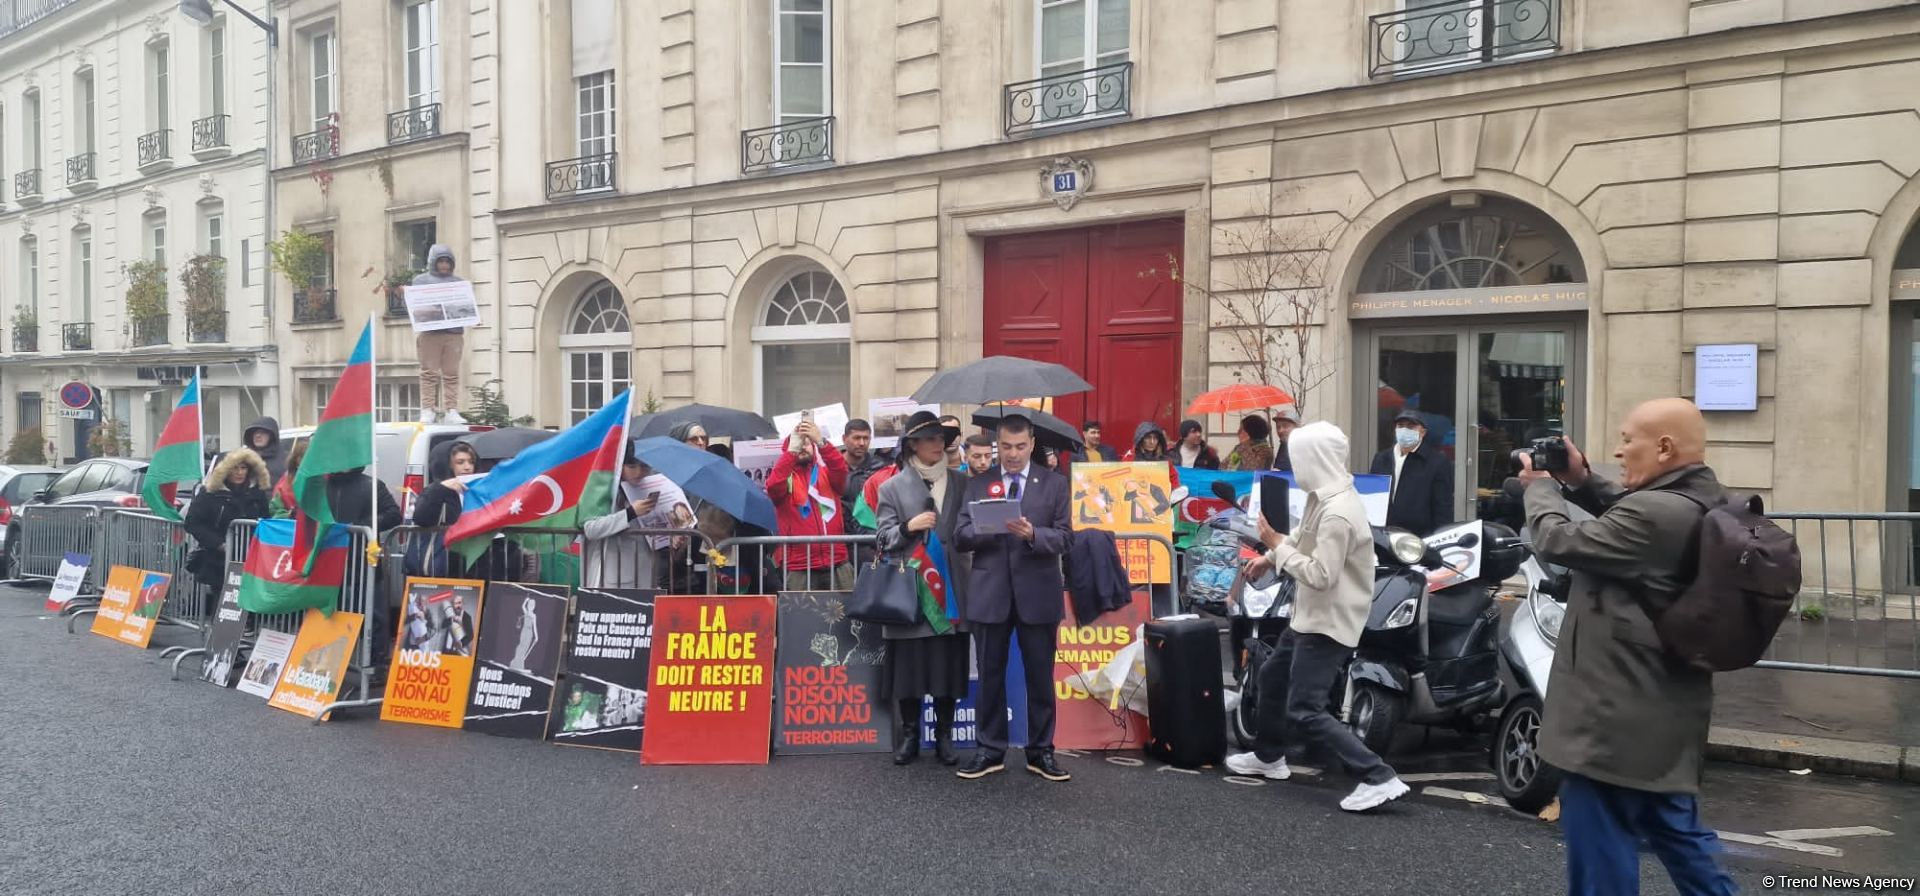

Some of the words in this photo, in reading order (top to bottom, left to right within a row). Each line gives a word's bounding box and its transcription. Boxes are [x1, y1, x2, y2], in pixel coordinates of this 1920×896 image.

[1058, 174, 1072, 190] 31
[1352, 300, 1408, 311] PHILIPPE
[1413, 298, 1473, 308] MENAGER
[1490, 293, 1551, 305] NICOLAS
[580, 610, 600, 622] Pour
[600, 612, 637, 624] apporter
[637, 612, 647, 624] la
[699, 605, 728, 633] LA
[578, 622, 597, 634] Paix
[597, 624, 608, 634] au
[608, 623, 646, 636] Caucase
[1060, 626, 1132, 646] NOUS
[576, 634, 593, 646] Sud
[593, 634, 603, 646] la
[603, 635, 633, 648] France
[633, 636, 652, 649] doit
[666, 632, 758, 661] FRANCE
[399, 648, 442, 667] NOUS
[575, 646, 601, 658] rester
[601, 648, 631, 660] neutre
[395, 665, 451, 686] DISONS
[479, 666, 503, 682] Nous
[656, 664, 696, 686] DOIT
[700, 664, 763, 686] RESTER
[784, 665, 848, 686] NOUS
[391, 683, 428, 702] NON
[428, 686, 451, 704] AU
[476, 679, 532, 698] demandons
[784, 684, 868, 706] DISONS
[474, 692, 485, 706] la
[668, 690, 734, 712] NEUTRE
[739, 690, 748, 712] !
[388, 704, 452, 723] TERRORISME
[784, 704, 838, 725] NON
[840, 703, 871, 724] AU
[783, 729, 878, 745] TERRORISME
